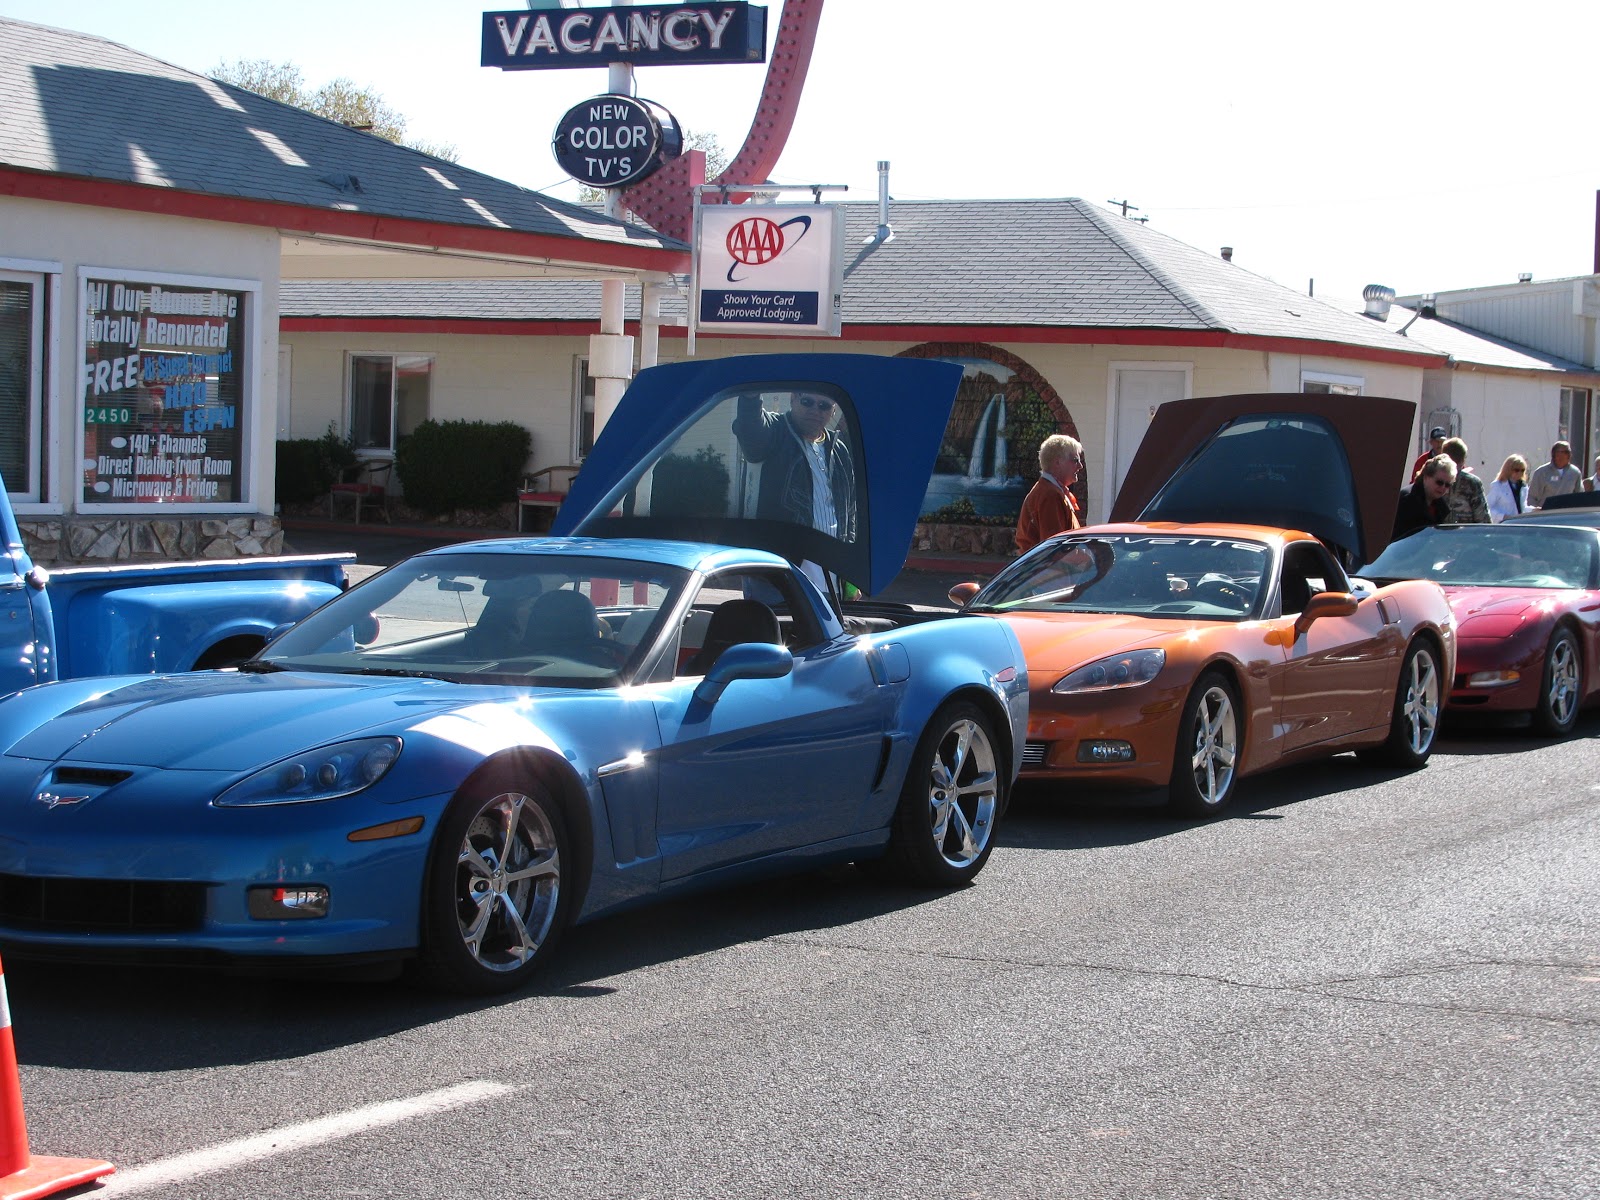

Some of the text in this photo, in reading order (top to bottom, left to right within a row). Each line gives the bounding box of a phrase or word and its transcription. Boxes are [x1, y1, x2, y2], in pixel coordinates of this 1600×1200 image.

[494, 8, 736, 56] VACANCY
[590, 104, 629, 122] NEW
[570, 125, 648, 150] COLOR
[585, 156, 632, 178] TV'S
[731, 219, 780, 262] AAA
[87, 282, 108, 312] All
[113, 283, 144, 312] Our
[209, 290, 238, 318] Are
[723, 294, 796, 306] Show Your Card
[717, 306, 801, 321] Approved Lodging
[86, 314, 228, 348] Totally Renovated
[85, 354, 139, 396] FREE
[165, 382, 207, 409] HBO
[87, 408, 129, 423] 2450
[183, 405, 235, 433] ESPN
[129, 434, 207, 454] 140+ Channels
[97, 456, 232, 478] Direct Dialing from Room
[112, 478, 218, 500] Microwave & Fridge
